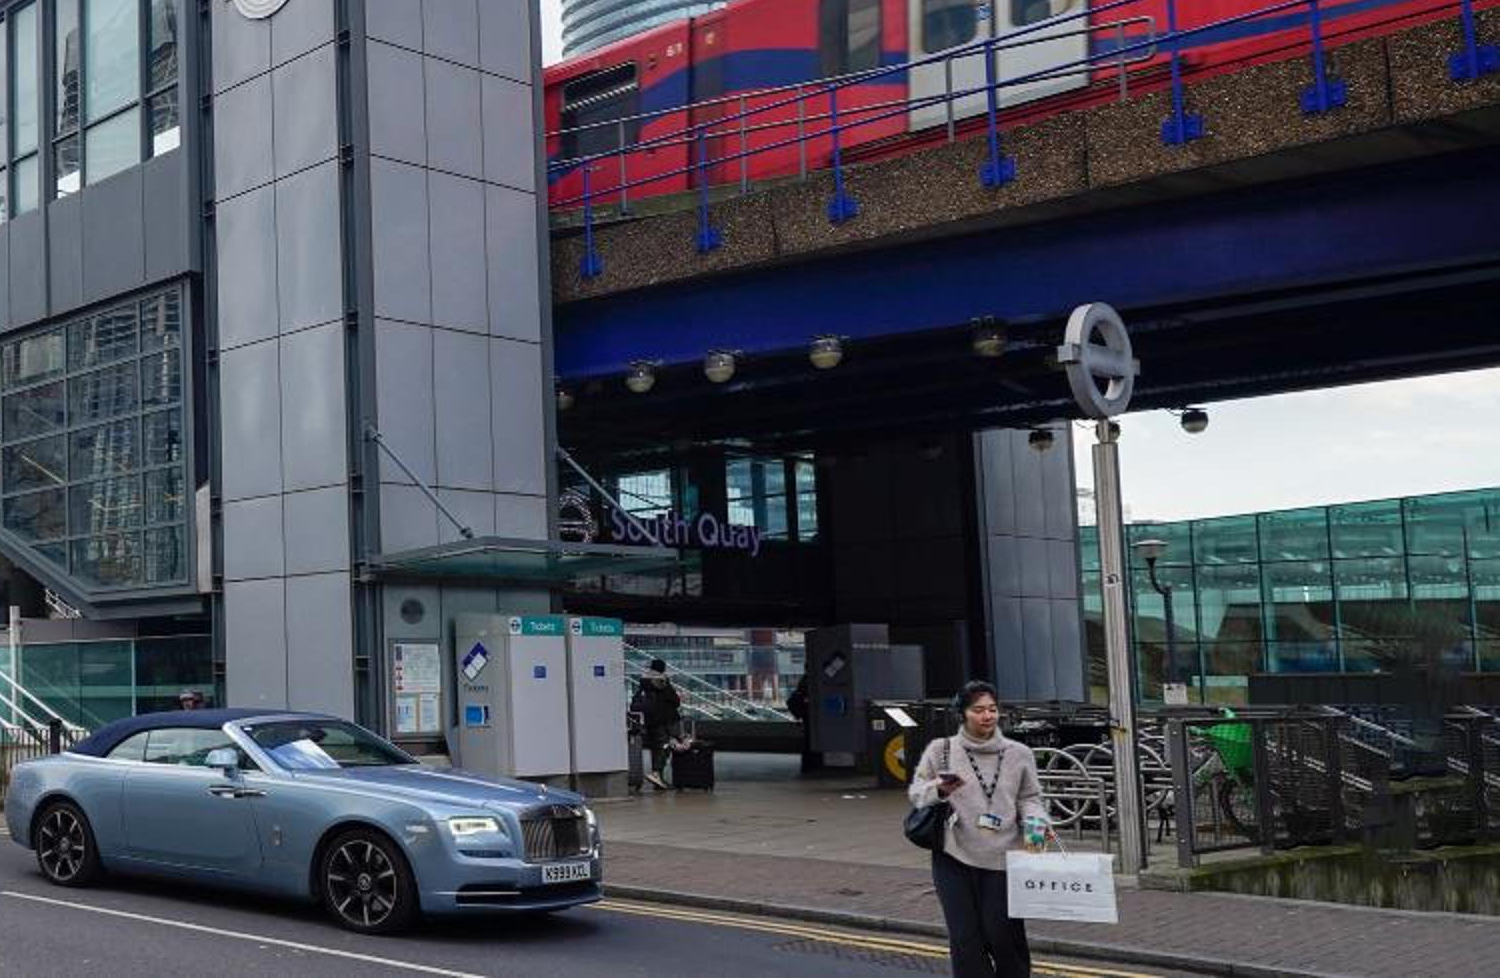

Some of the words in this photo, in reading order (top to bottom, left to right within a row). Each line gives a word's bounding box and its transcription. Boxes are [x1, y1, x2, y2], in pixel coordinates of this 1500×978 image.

[611, 508, 690, 545] South
[697, 512, 763, 557] Quay
[1024, 879, 1093, 893] OFFICE
